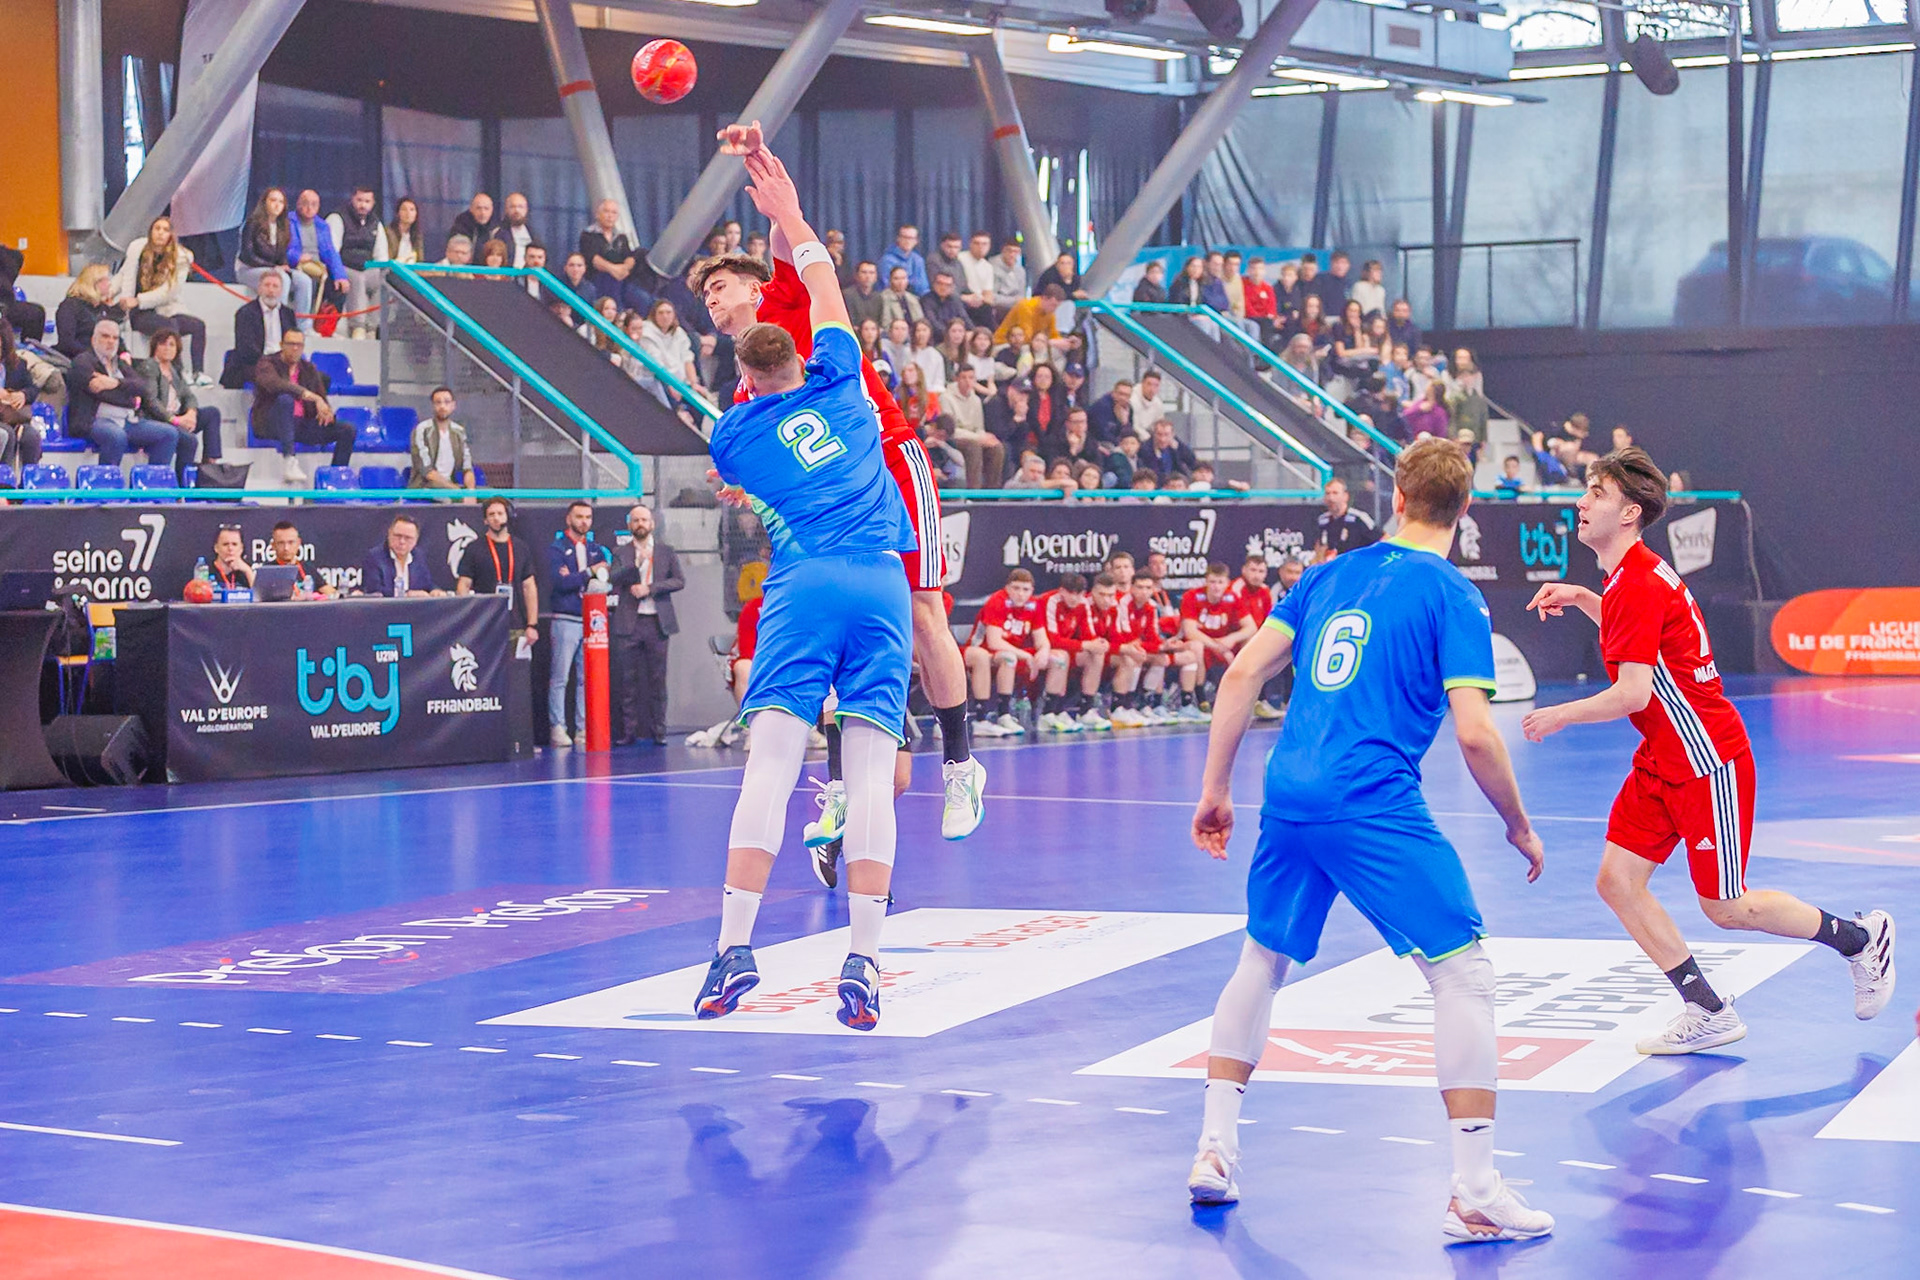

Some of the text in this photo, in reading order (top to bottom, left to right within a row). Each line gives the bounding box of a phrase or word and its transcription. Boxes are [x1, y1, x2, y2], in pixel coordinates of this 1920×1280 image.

[777, 408, 848, 472] 2
[121, 513, 166, 573] 77
[1020, 529, 1119, 564] Agencity
[1149, 529, 1192, 554] seine
[1189, 508, 1217, 555] 77
[53, 541, 123, 574] seine
[1311, 608, 1372, 692] 6
[1819, 634, 1846, 650] DE
[181, 705, 268, 723] VAL D'EUROPE
[310, 721, 381, 739] VAL D'EUROPE
